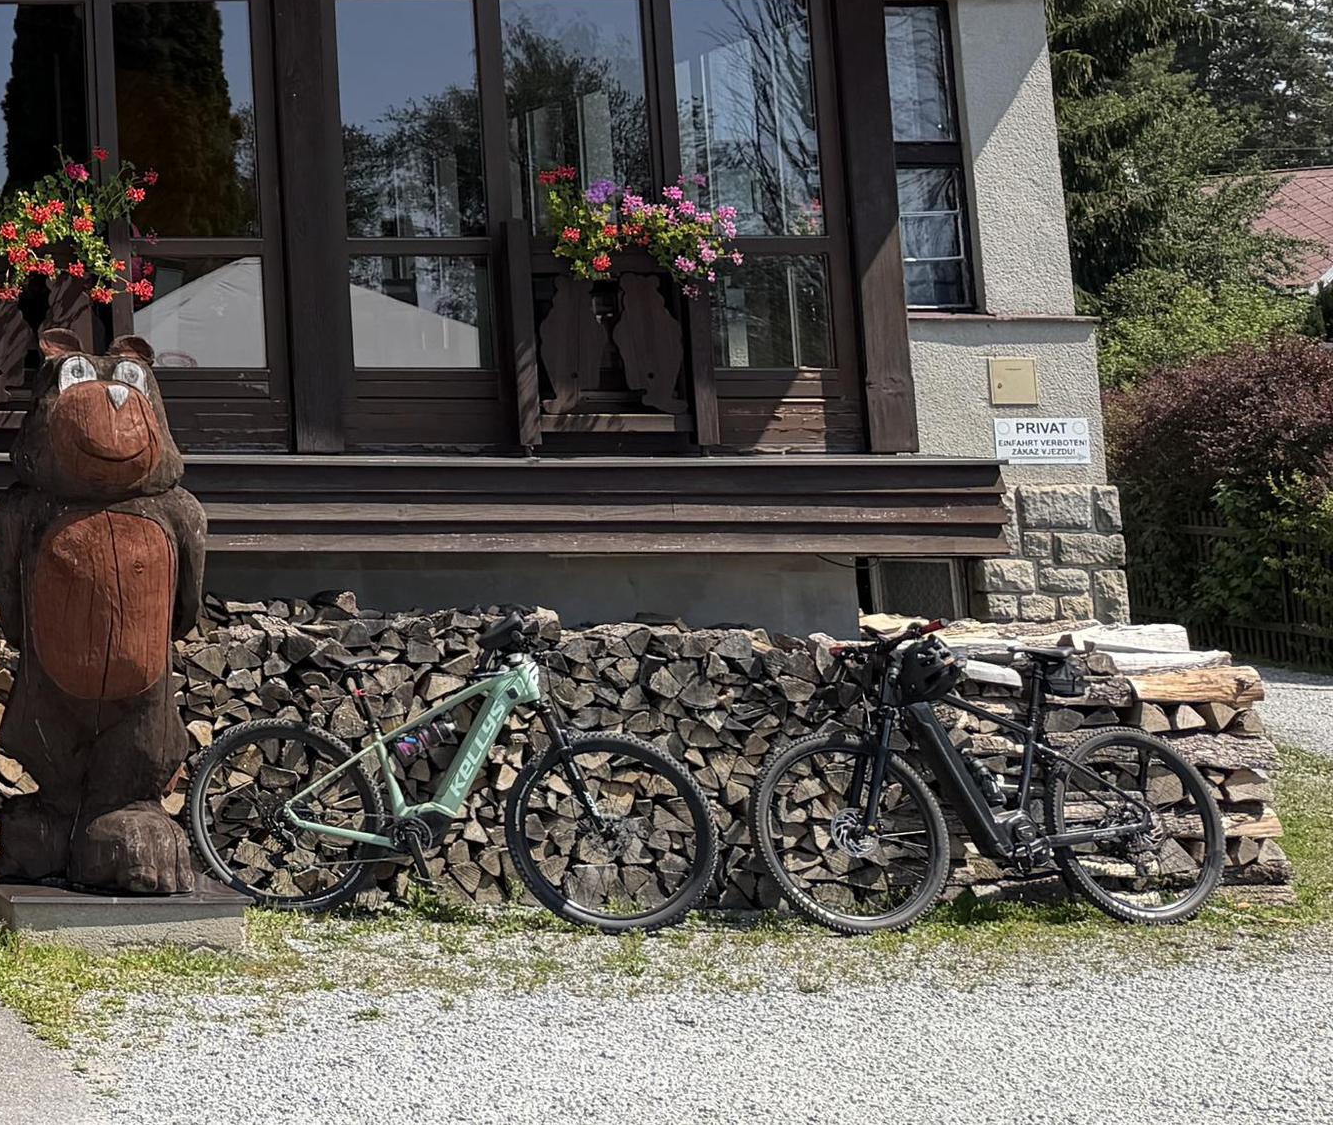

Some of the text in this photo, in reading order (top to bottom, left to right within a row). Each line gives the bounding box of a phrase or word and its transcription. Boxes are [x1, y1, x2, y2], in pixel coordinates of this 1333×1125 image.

[1015, 422, 1068, 435] PRIVAT
[998, 439, 1088, 447] EINFAHRT VERBOTEN!
